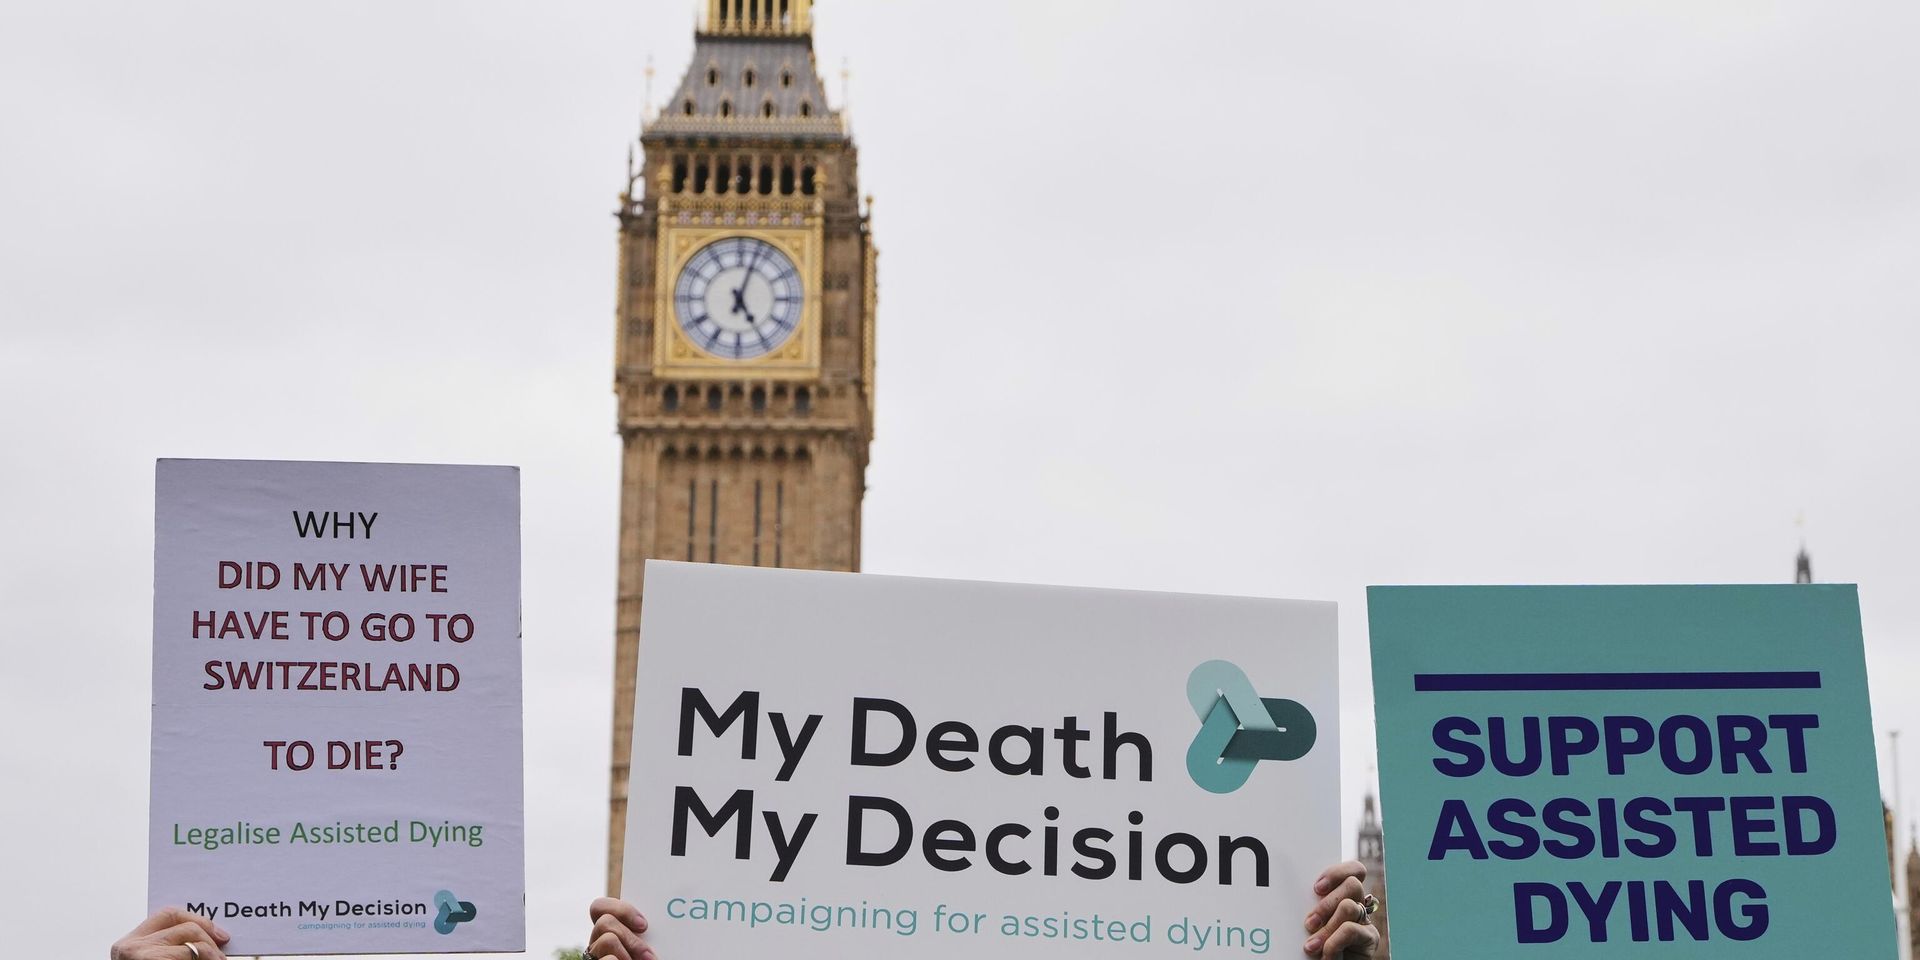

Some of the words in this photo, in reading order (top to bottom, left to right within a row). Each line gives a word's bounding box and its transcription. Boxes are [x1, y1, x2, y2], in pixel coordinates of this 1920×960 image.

[293, 511, 378, 539] WHY
[218, 561, 280, 590] DID
[293, 563, 350, 591] MY
[360, 564, 448, 593] WIFE
[192, 610, 289, 640] HAVE
[300, 611, 349, 641] TO
[361, 613, 415, 642] GO
[426, 614, 474, 643] TO
[203, 660, 460, 692] SWITZERLAND
[678, 687, 823, 781] My
[850, 697, 1153, 782] Death
[1432, 714, 1819, 777] SUPPORT
[263, 741, 314, 771] TO
[327, 740, 404, 770] DIE?
[173, 822, 281, 850] Legalise
[290, 820, 399, 844] Assisted
[409, 820, 483, 848] Dying
[670, 786, 818, 882] My
[846, 795, 1270, 887] Decision
[1427, 795, 1837, 861] ASSISTED
[187, 902, 218, 921] My
[224, 901, 292, 918] Death
[299, 900, 330, 920] My
[335, 899, 427, 917] Decision
[297, 922, 352, 930] campaigning
[353, 921, 365, 929] for
[367, 921, 401, 929] assisted
[402, 920, 427, 929] dying
[666, 894, 918, 937] campaigning
[933, 905, 988, 935] for
[1000, 910, 1152, 945] assisted
[1166, 916, 1271, 955] dying
[1513, 879, 1769, 943] DYING
